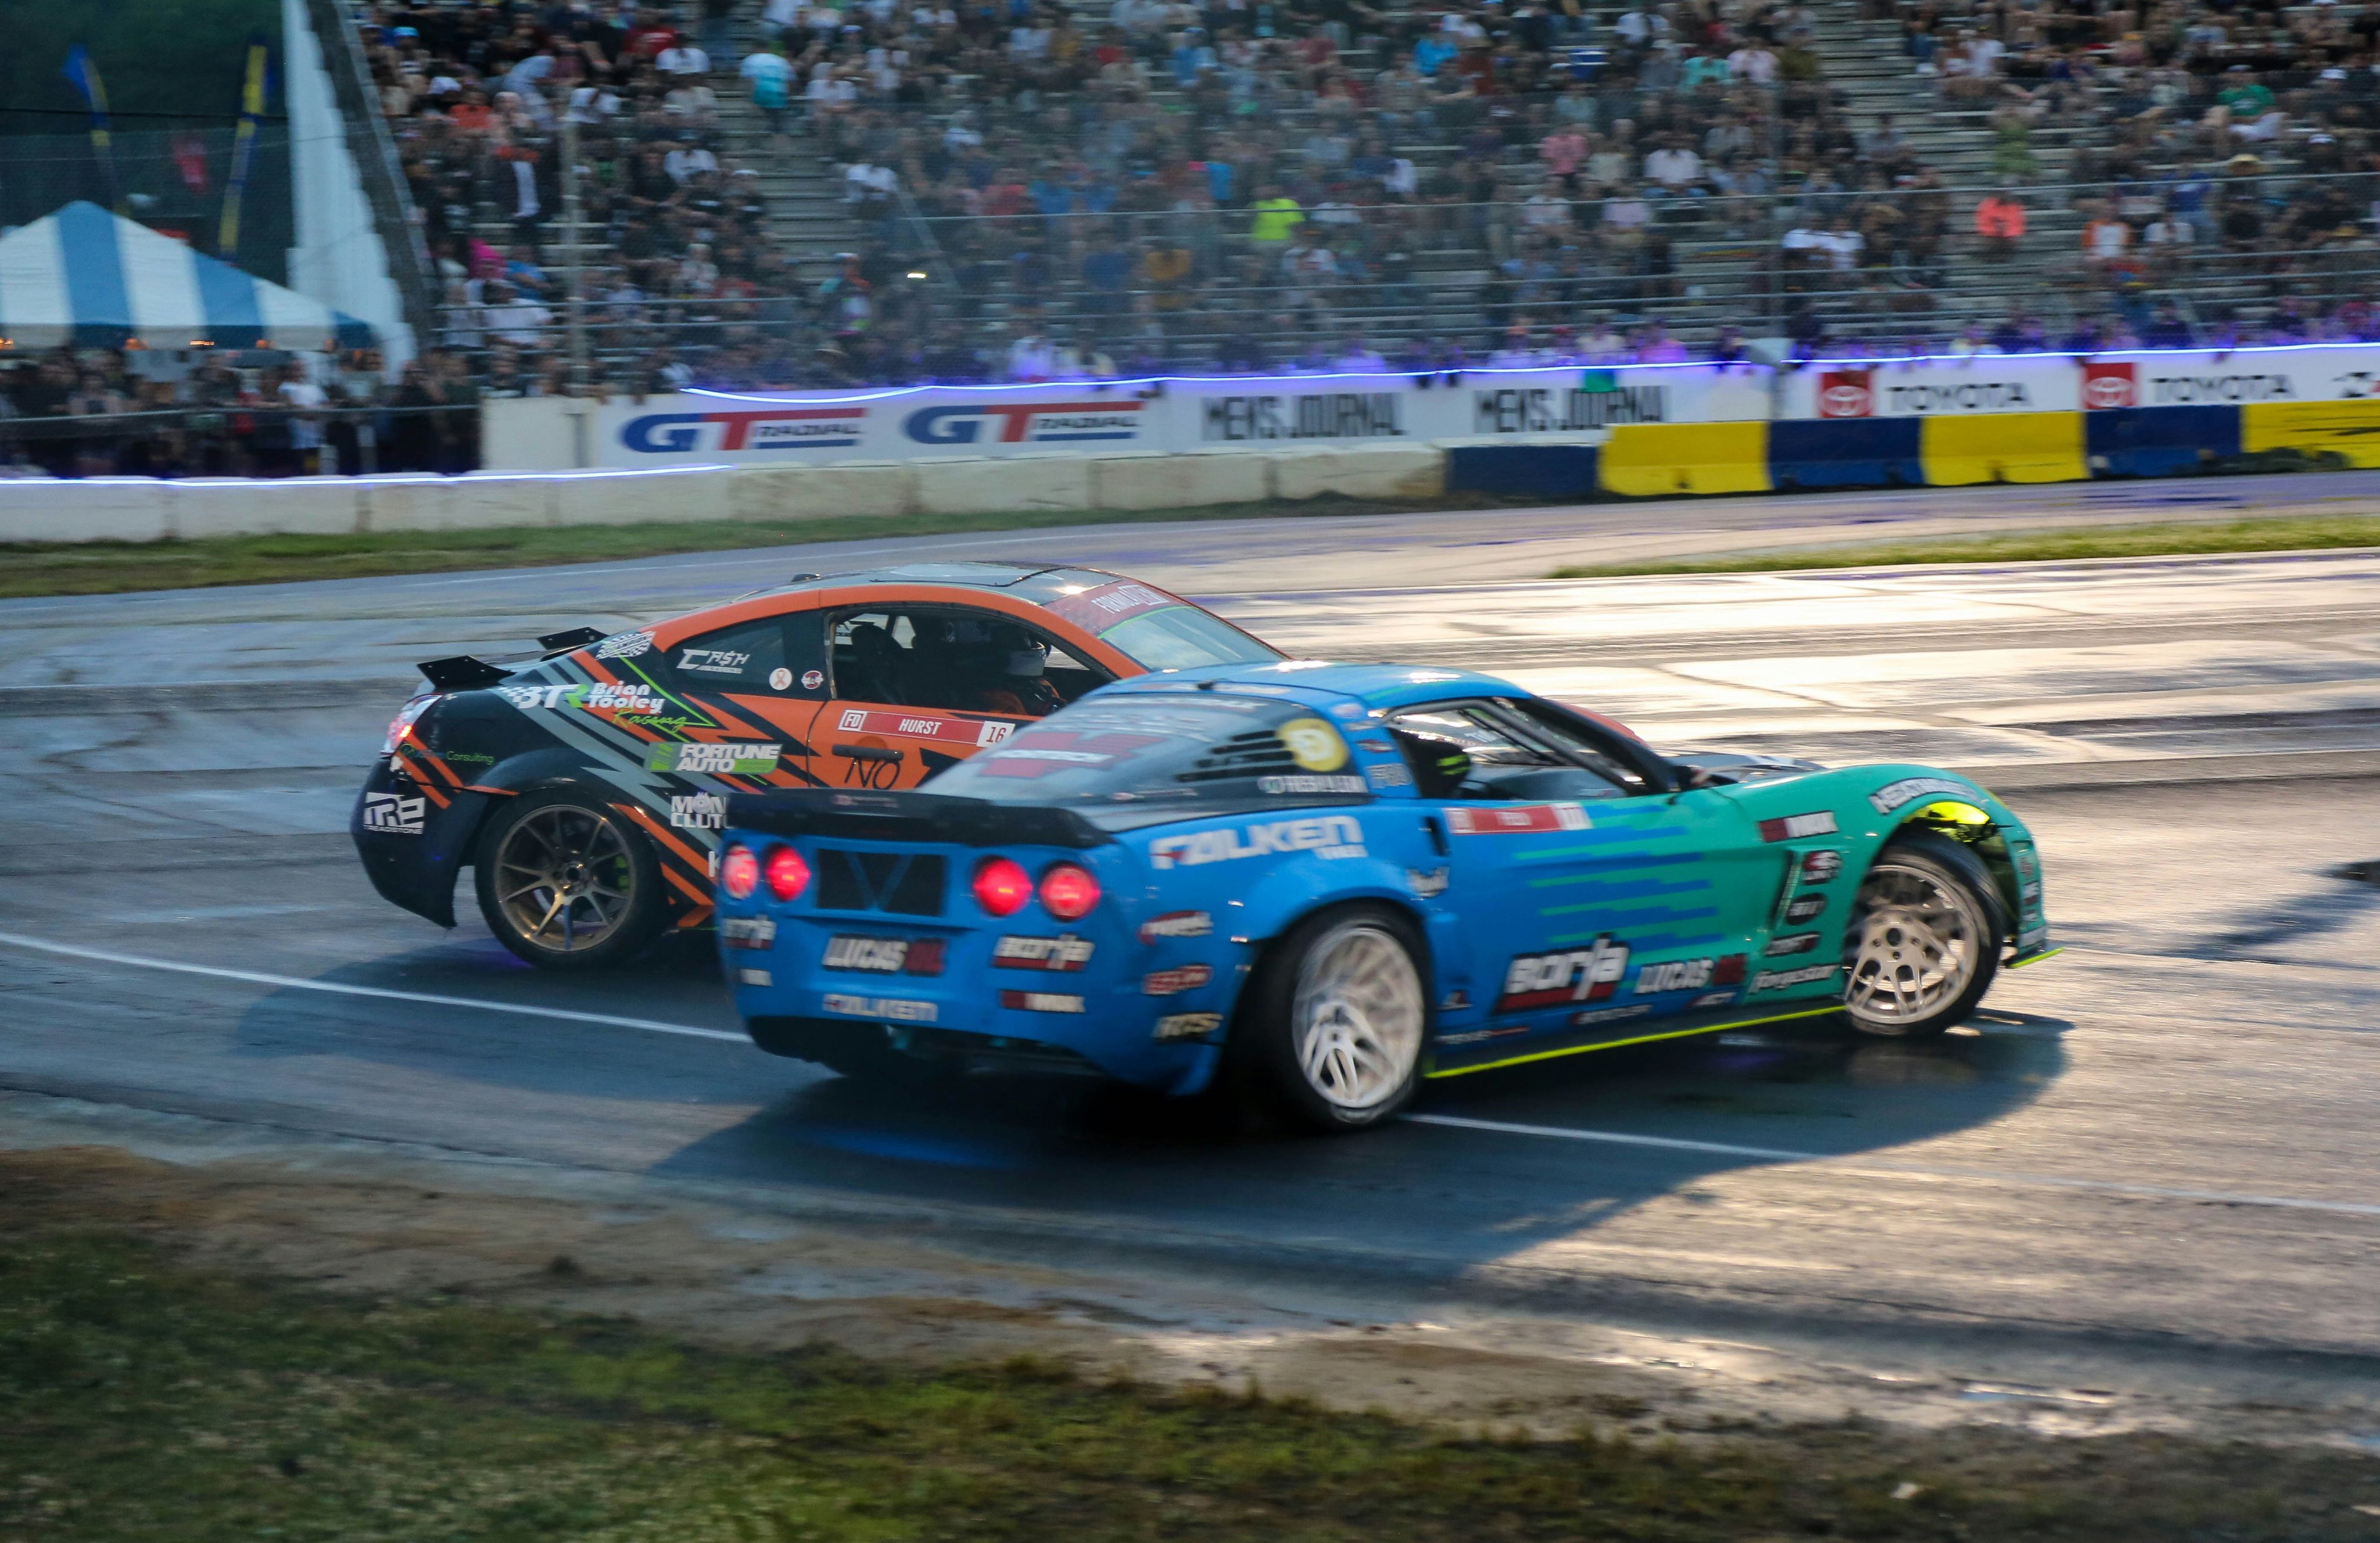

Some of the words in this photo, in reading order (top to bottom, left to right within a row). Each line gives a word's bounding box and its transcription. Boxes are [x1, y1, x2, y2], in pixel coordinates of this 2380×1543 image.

[1886, 383, 2029, 411] TOYOTA
[2151, 375, 2297, 403] TOYOTA
[510, 684, 589, 709] BTR
[591, 680, 651, 695] Brian
[588, 695, 665, 714] Tooley
[898, 719, 942, 735] HURST
[985, 726, 1007, 743] 16
[679, 744, 781, 759] FORTUNE
[676, 758, 736, 772] AUTO
[843, 758, 900, 790] NO
[1148, 815, 1365, 870] FALKEN
[1633, 957, 1715, 995] LUCAS
